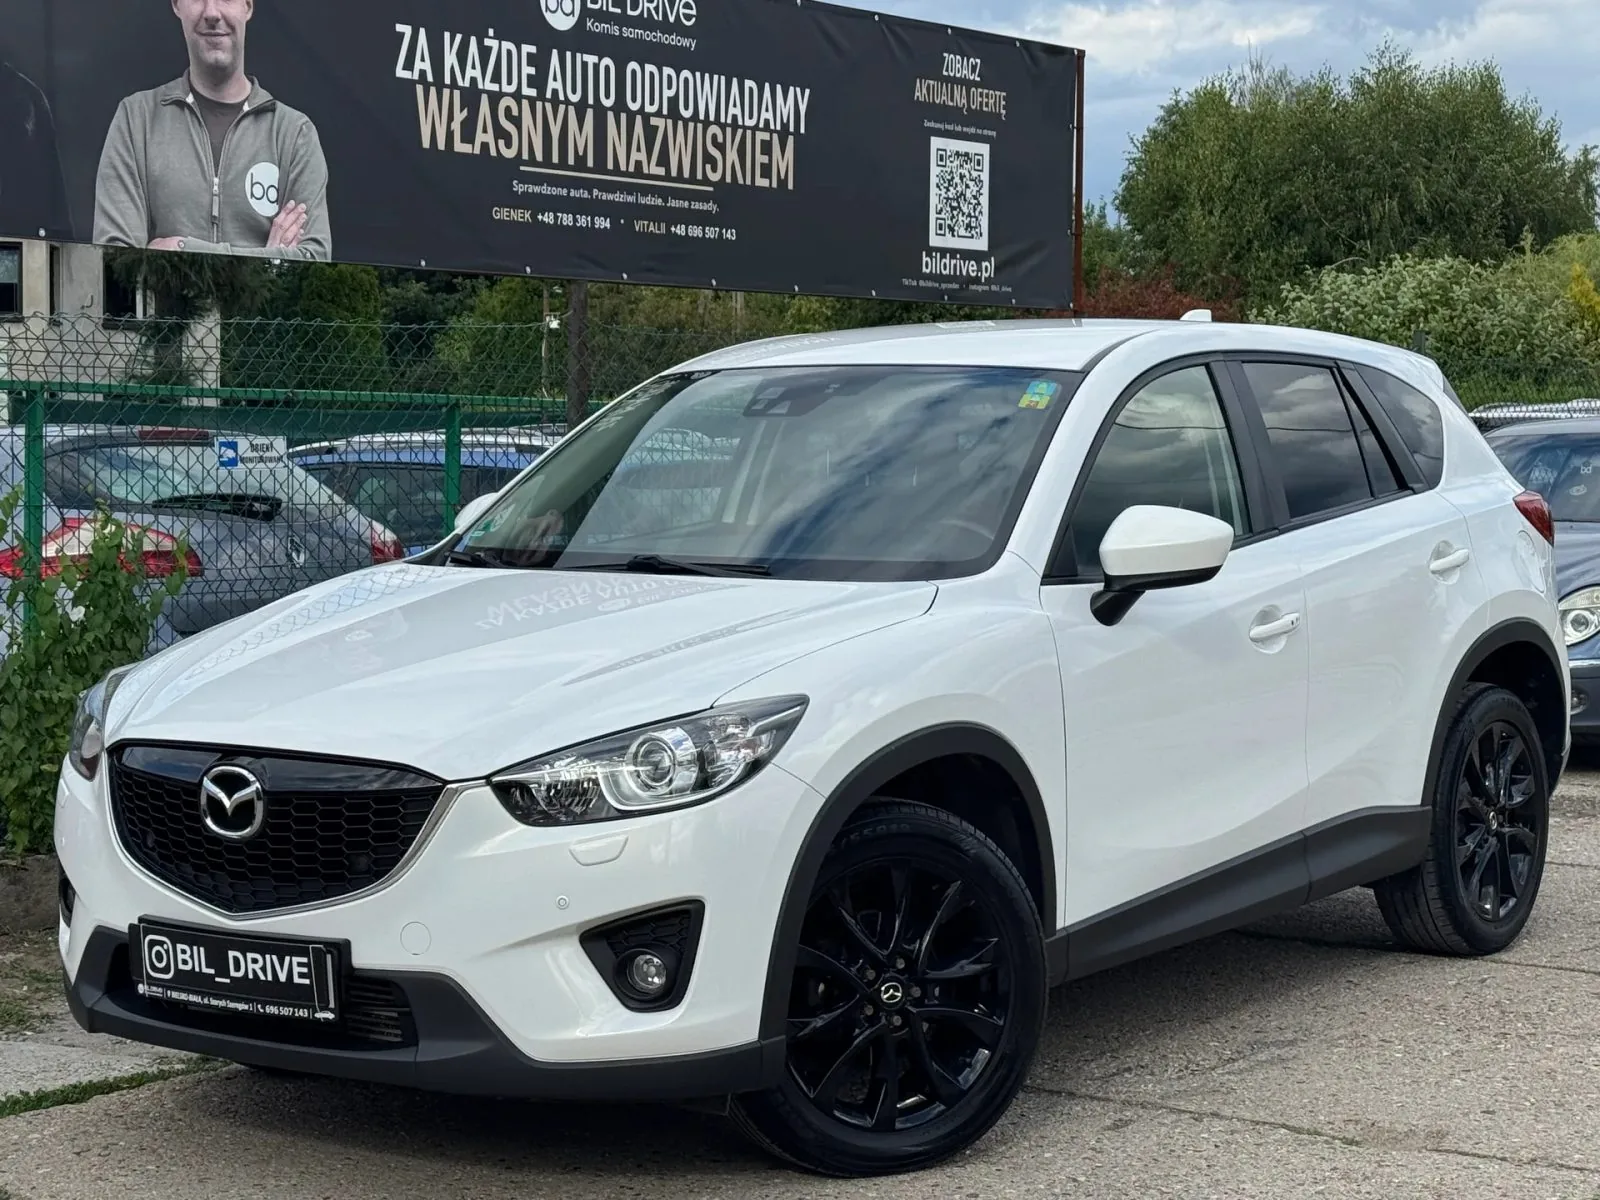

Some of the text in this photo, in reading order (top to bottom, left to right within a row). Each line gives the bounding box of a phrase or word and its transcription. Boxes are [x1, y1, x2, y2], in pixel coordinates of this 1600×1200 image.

[586, 17, 697, 51] Komis samochodowy
[395, 23, 811, 134] ZA KAŻDE AUTO ODPOWIADAMY
[942, 52, 981, 81] ZOBACZ
[914, 78, 1007, 121] AKTUALNĄ OFERTĘ
[415, 83, 794, 190] WŁASNYM NAZWISKIEM
[512, 180, 720, 214] Sprawdzone auta. Prawdziwi ludzie. Jasne zasady.
[492, 207, 736, 240] GIENEK +48 788 361 994 VITALII +48 696 507 143
[922, 250, 995, 283] bildrive.pl
[175, 943, 311, 984] BIL_DRIVE
[265, 1004, 279, 1015] 696
[279, 1006, 293, 1016] 507
[294, 1007, 308, 1018] 143
